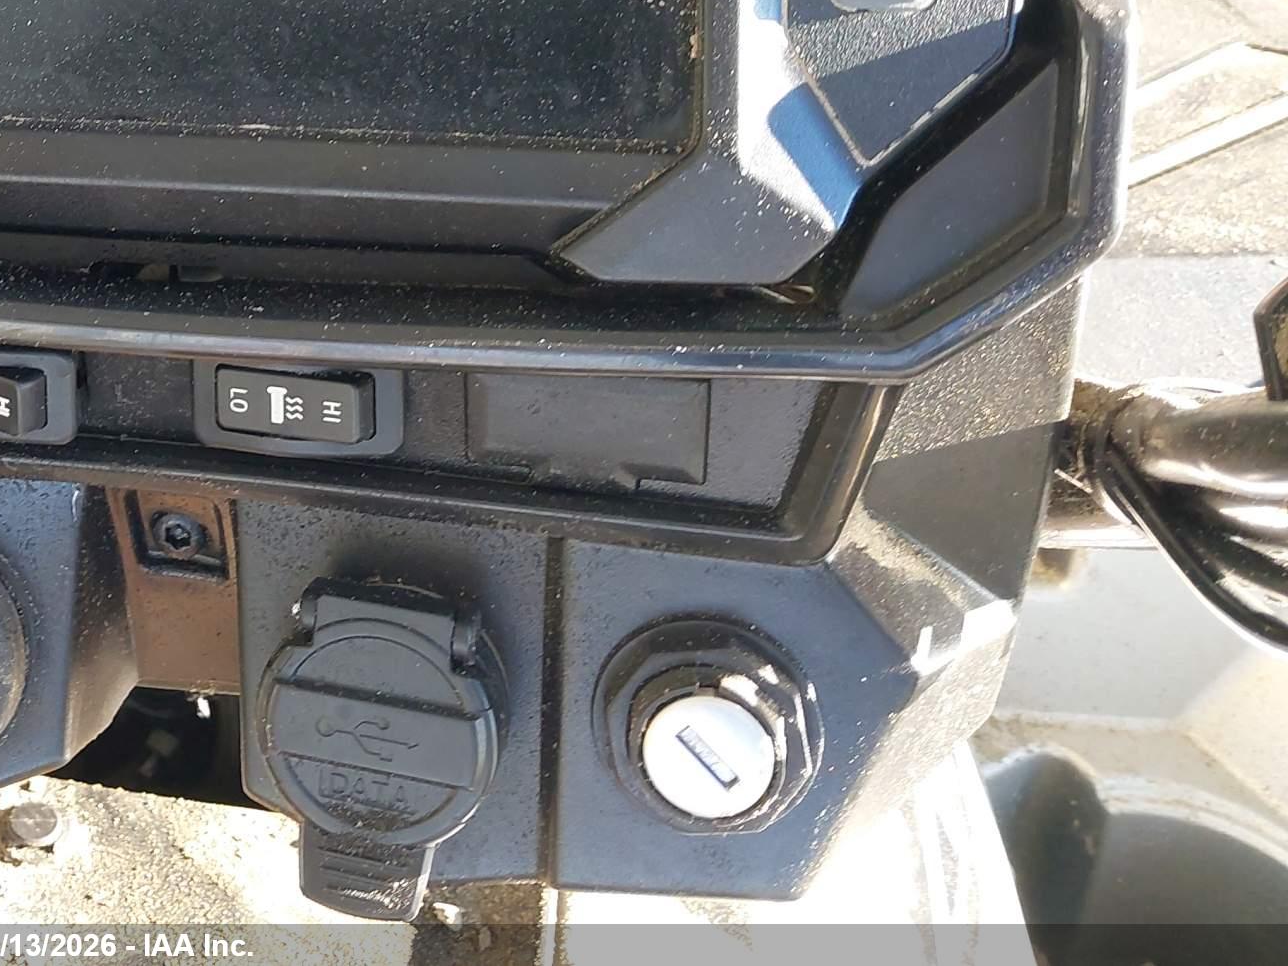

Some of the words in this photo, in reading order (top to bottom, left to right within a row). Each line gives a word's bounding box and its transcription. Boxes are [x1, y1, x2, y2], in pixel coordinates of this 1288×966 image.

[229, 387, 249, 413] LO
[322, 400, 342, 423] HI
[327, 771, 410, 807] DATA
